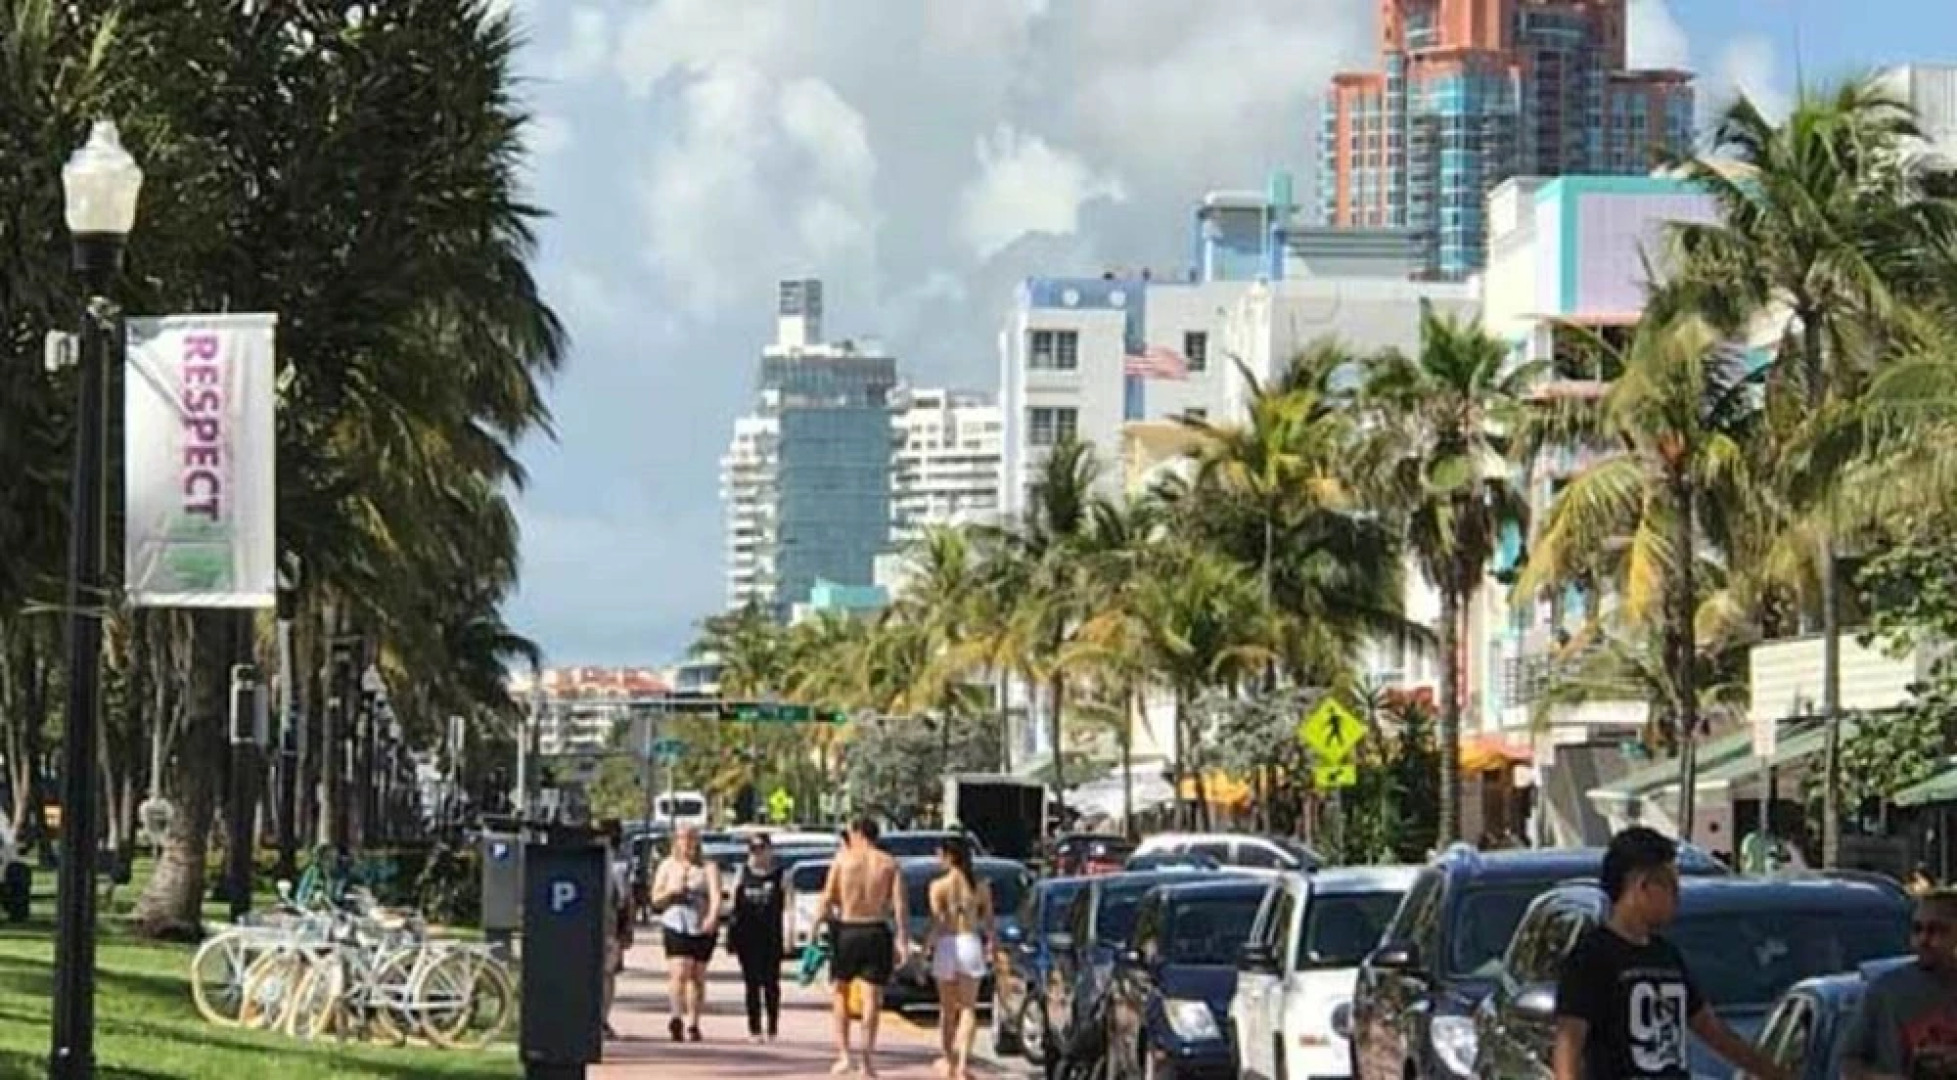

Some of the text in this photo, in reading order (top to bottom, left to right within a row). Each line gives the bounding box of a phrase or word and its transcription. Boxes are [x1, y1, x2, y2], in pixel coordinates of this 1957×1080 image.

[183, 335, 219, 522] RESPECT
[552, 882, 576, 911] P
[1630, 981, 1687, 1071] 97
